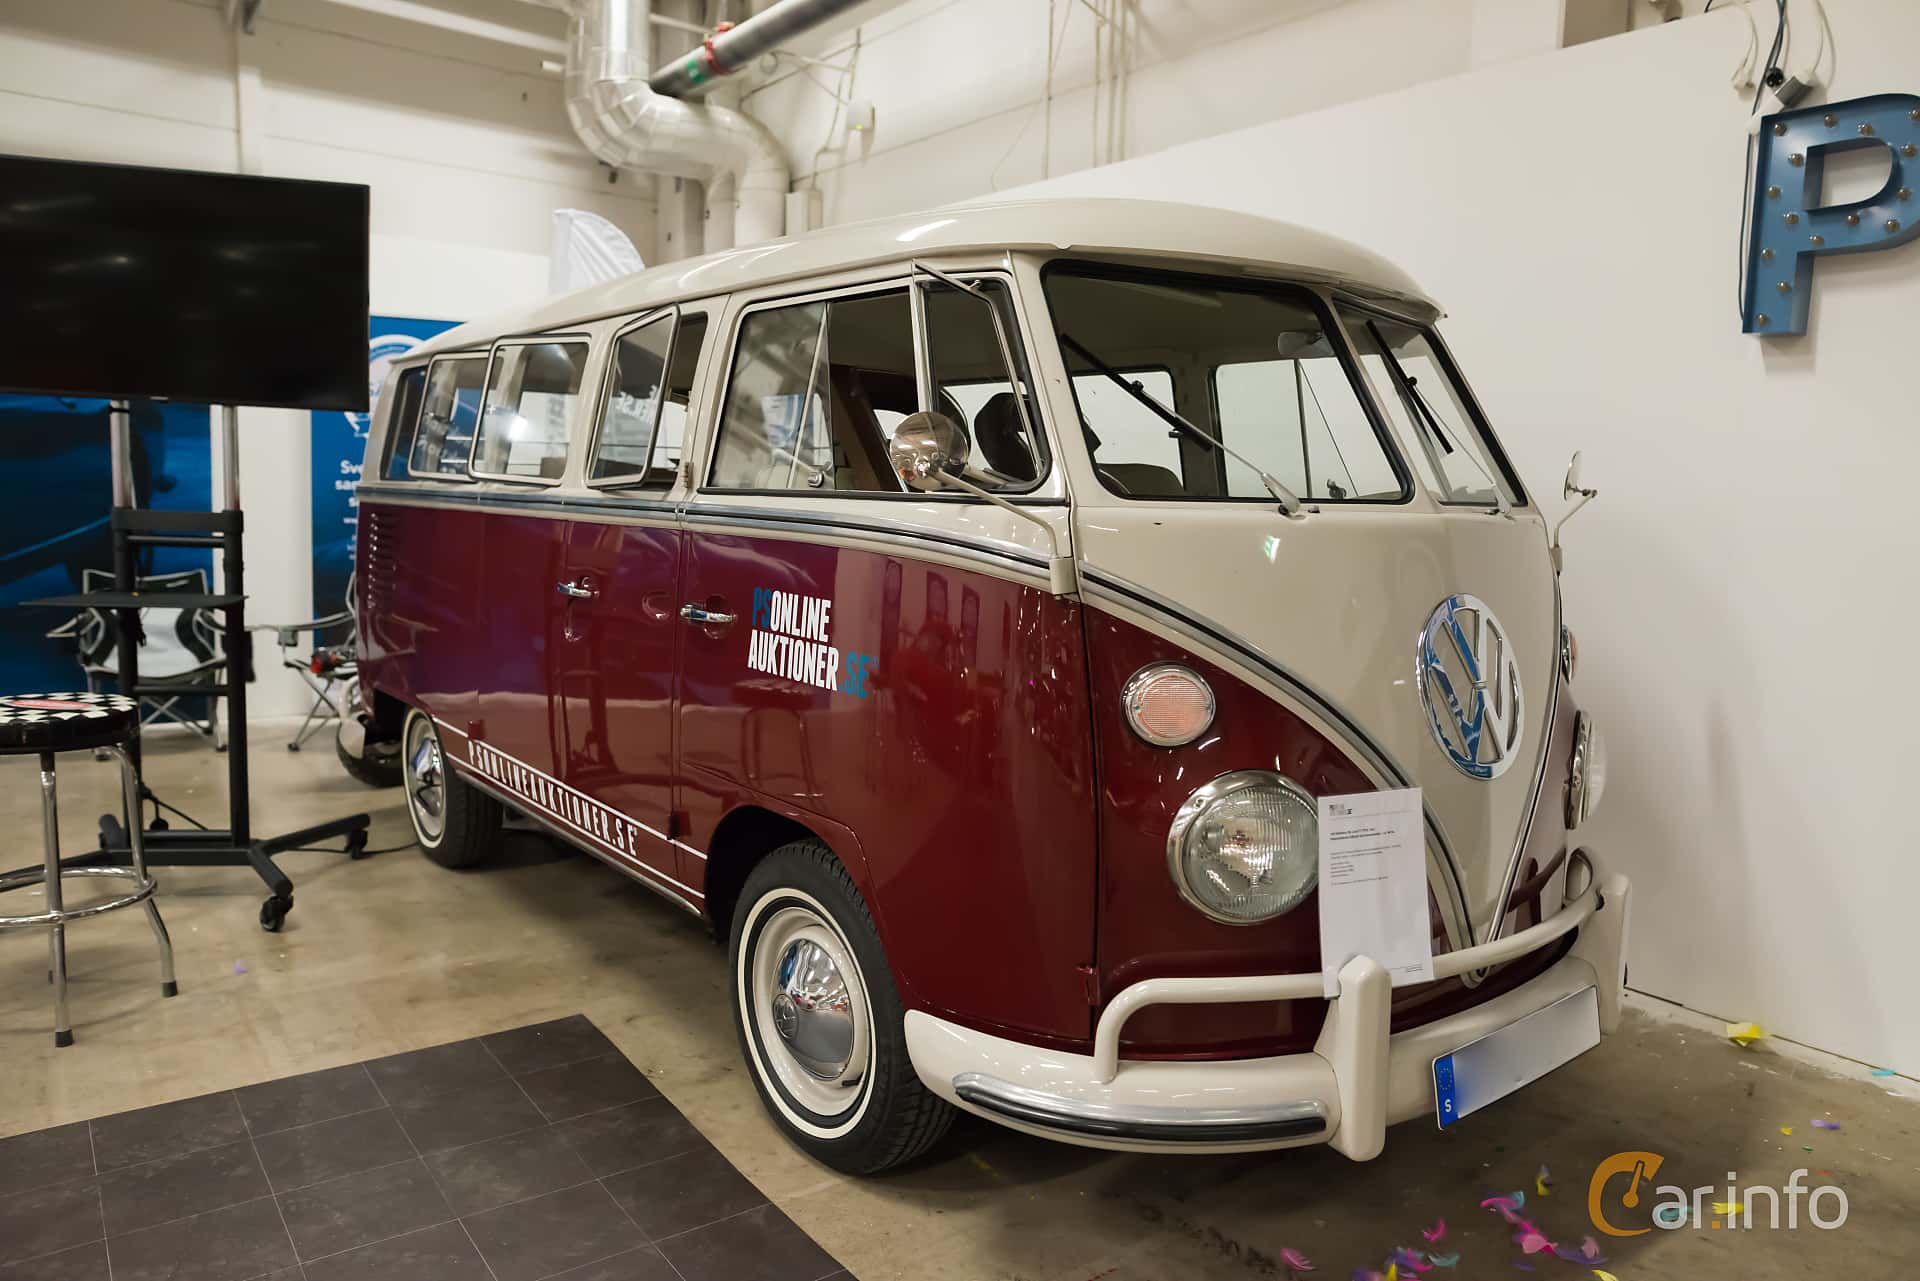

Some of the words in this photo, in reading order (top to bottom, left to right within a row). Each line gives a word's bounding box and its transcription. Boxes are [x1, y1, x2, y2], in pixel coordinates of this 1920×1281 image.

[1743, 93, 1920, 336] P
[751, 587, 831, 642] PSONLINE
[1444, 1098, 1452, 1113] S
